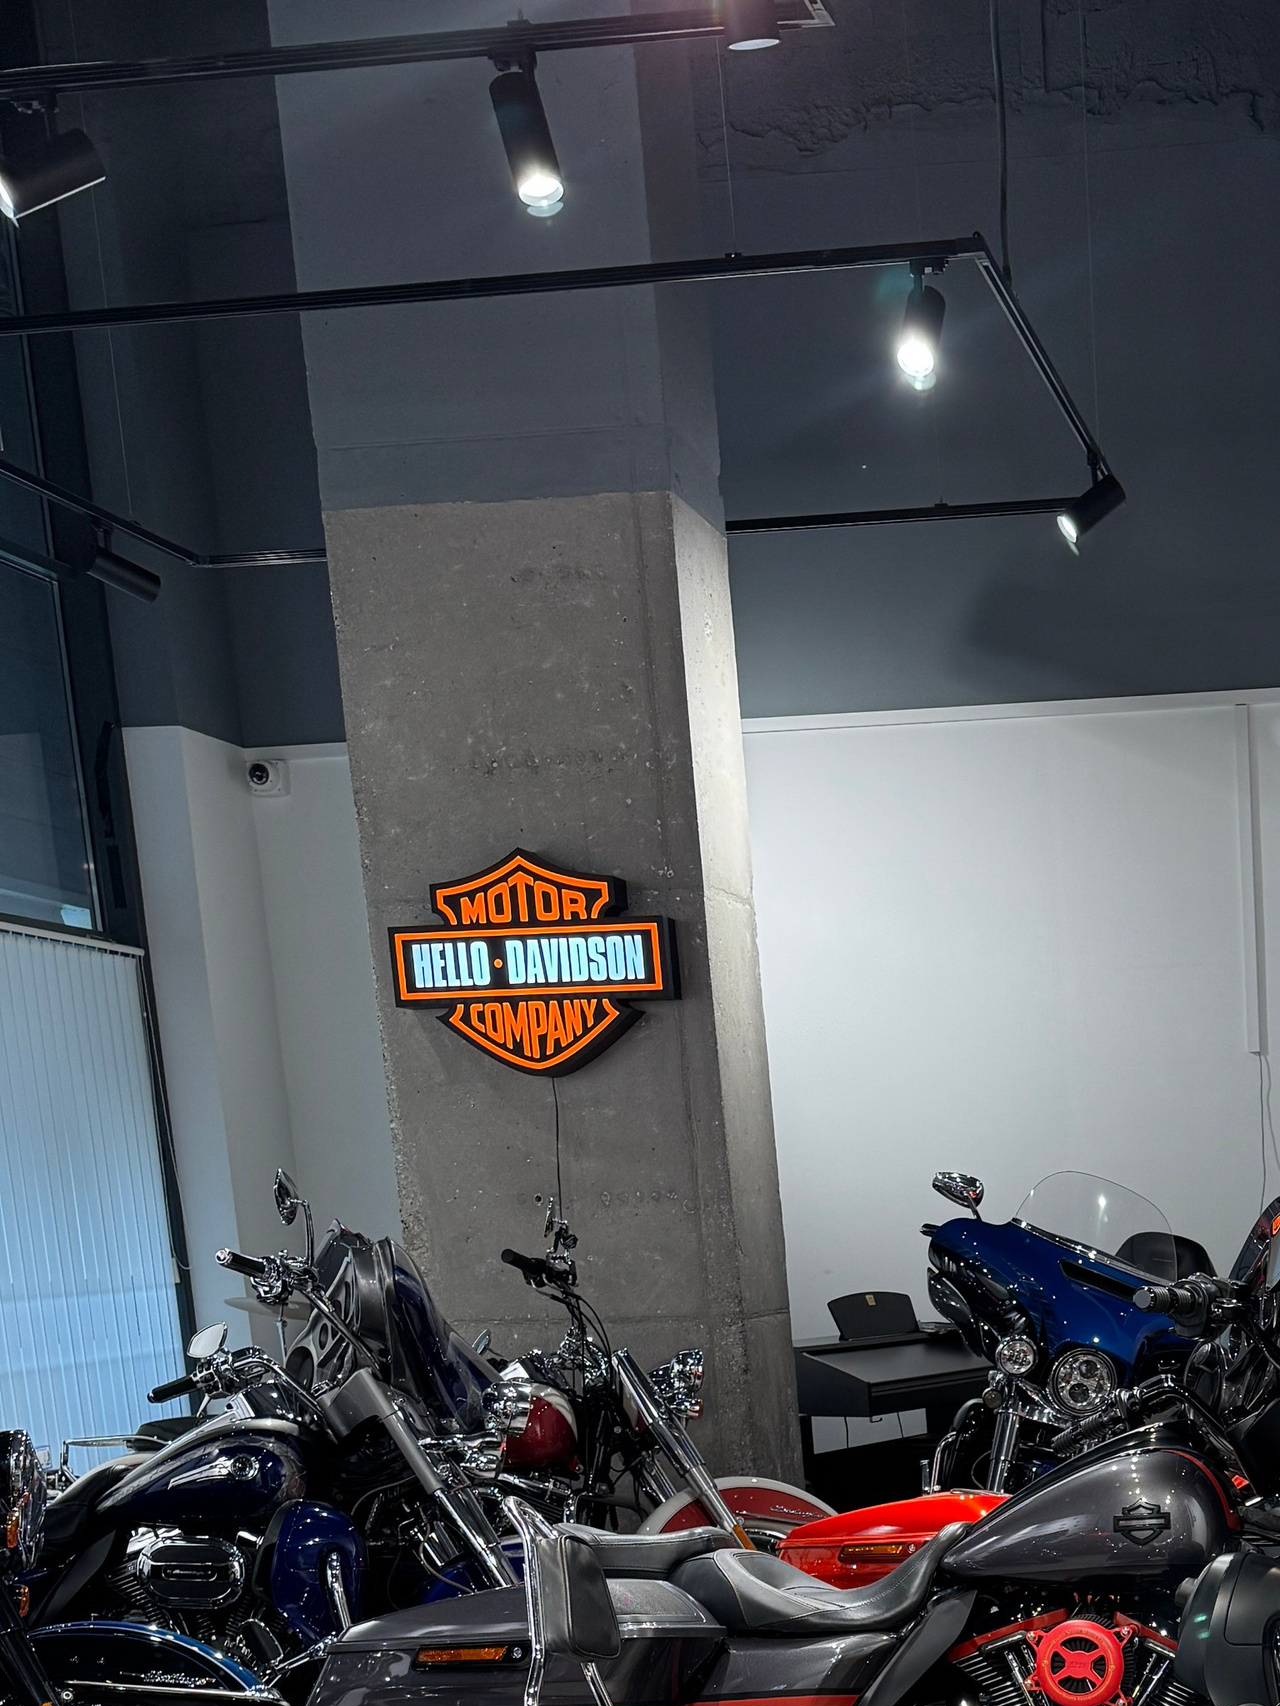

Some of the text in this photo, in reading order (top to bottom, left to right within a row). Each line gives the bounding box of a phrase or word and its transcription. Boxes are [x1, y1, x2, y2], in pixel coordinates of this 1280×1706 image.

[460, 870, 587, 925] MOTOR
[411, 935, 646, 989] HELLO DAVIDSON
[469, 998, 598, 1059] COMPANY
